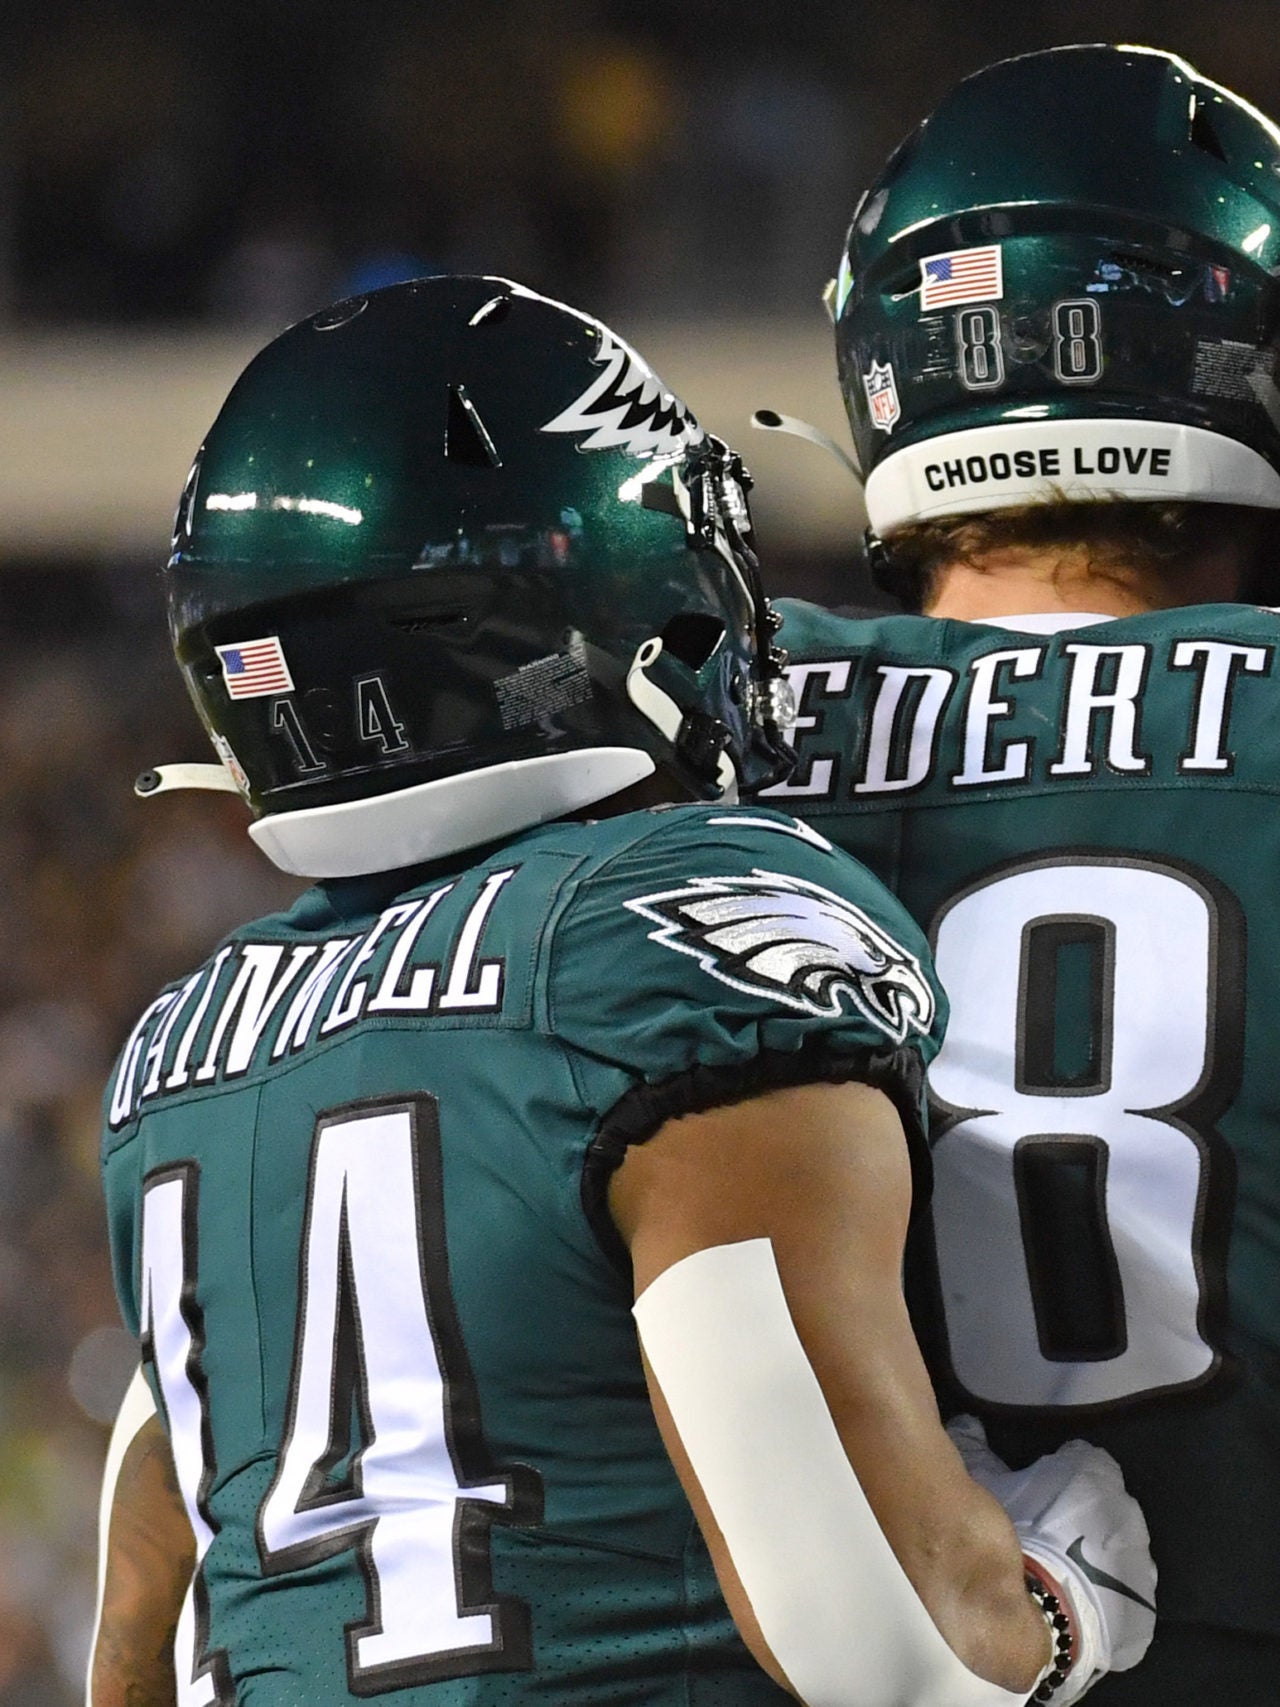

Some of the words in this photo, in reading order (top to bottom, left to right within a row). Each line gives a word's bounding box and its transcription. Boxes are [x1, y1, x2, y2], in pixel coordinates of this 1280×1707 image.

[924, 448, 1060, 492] CHOOSE
[1073, 446, 1172, 477] LOVE
[107, 864, 517, 1129] GAINWELL
